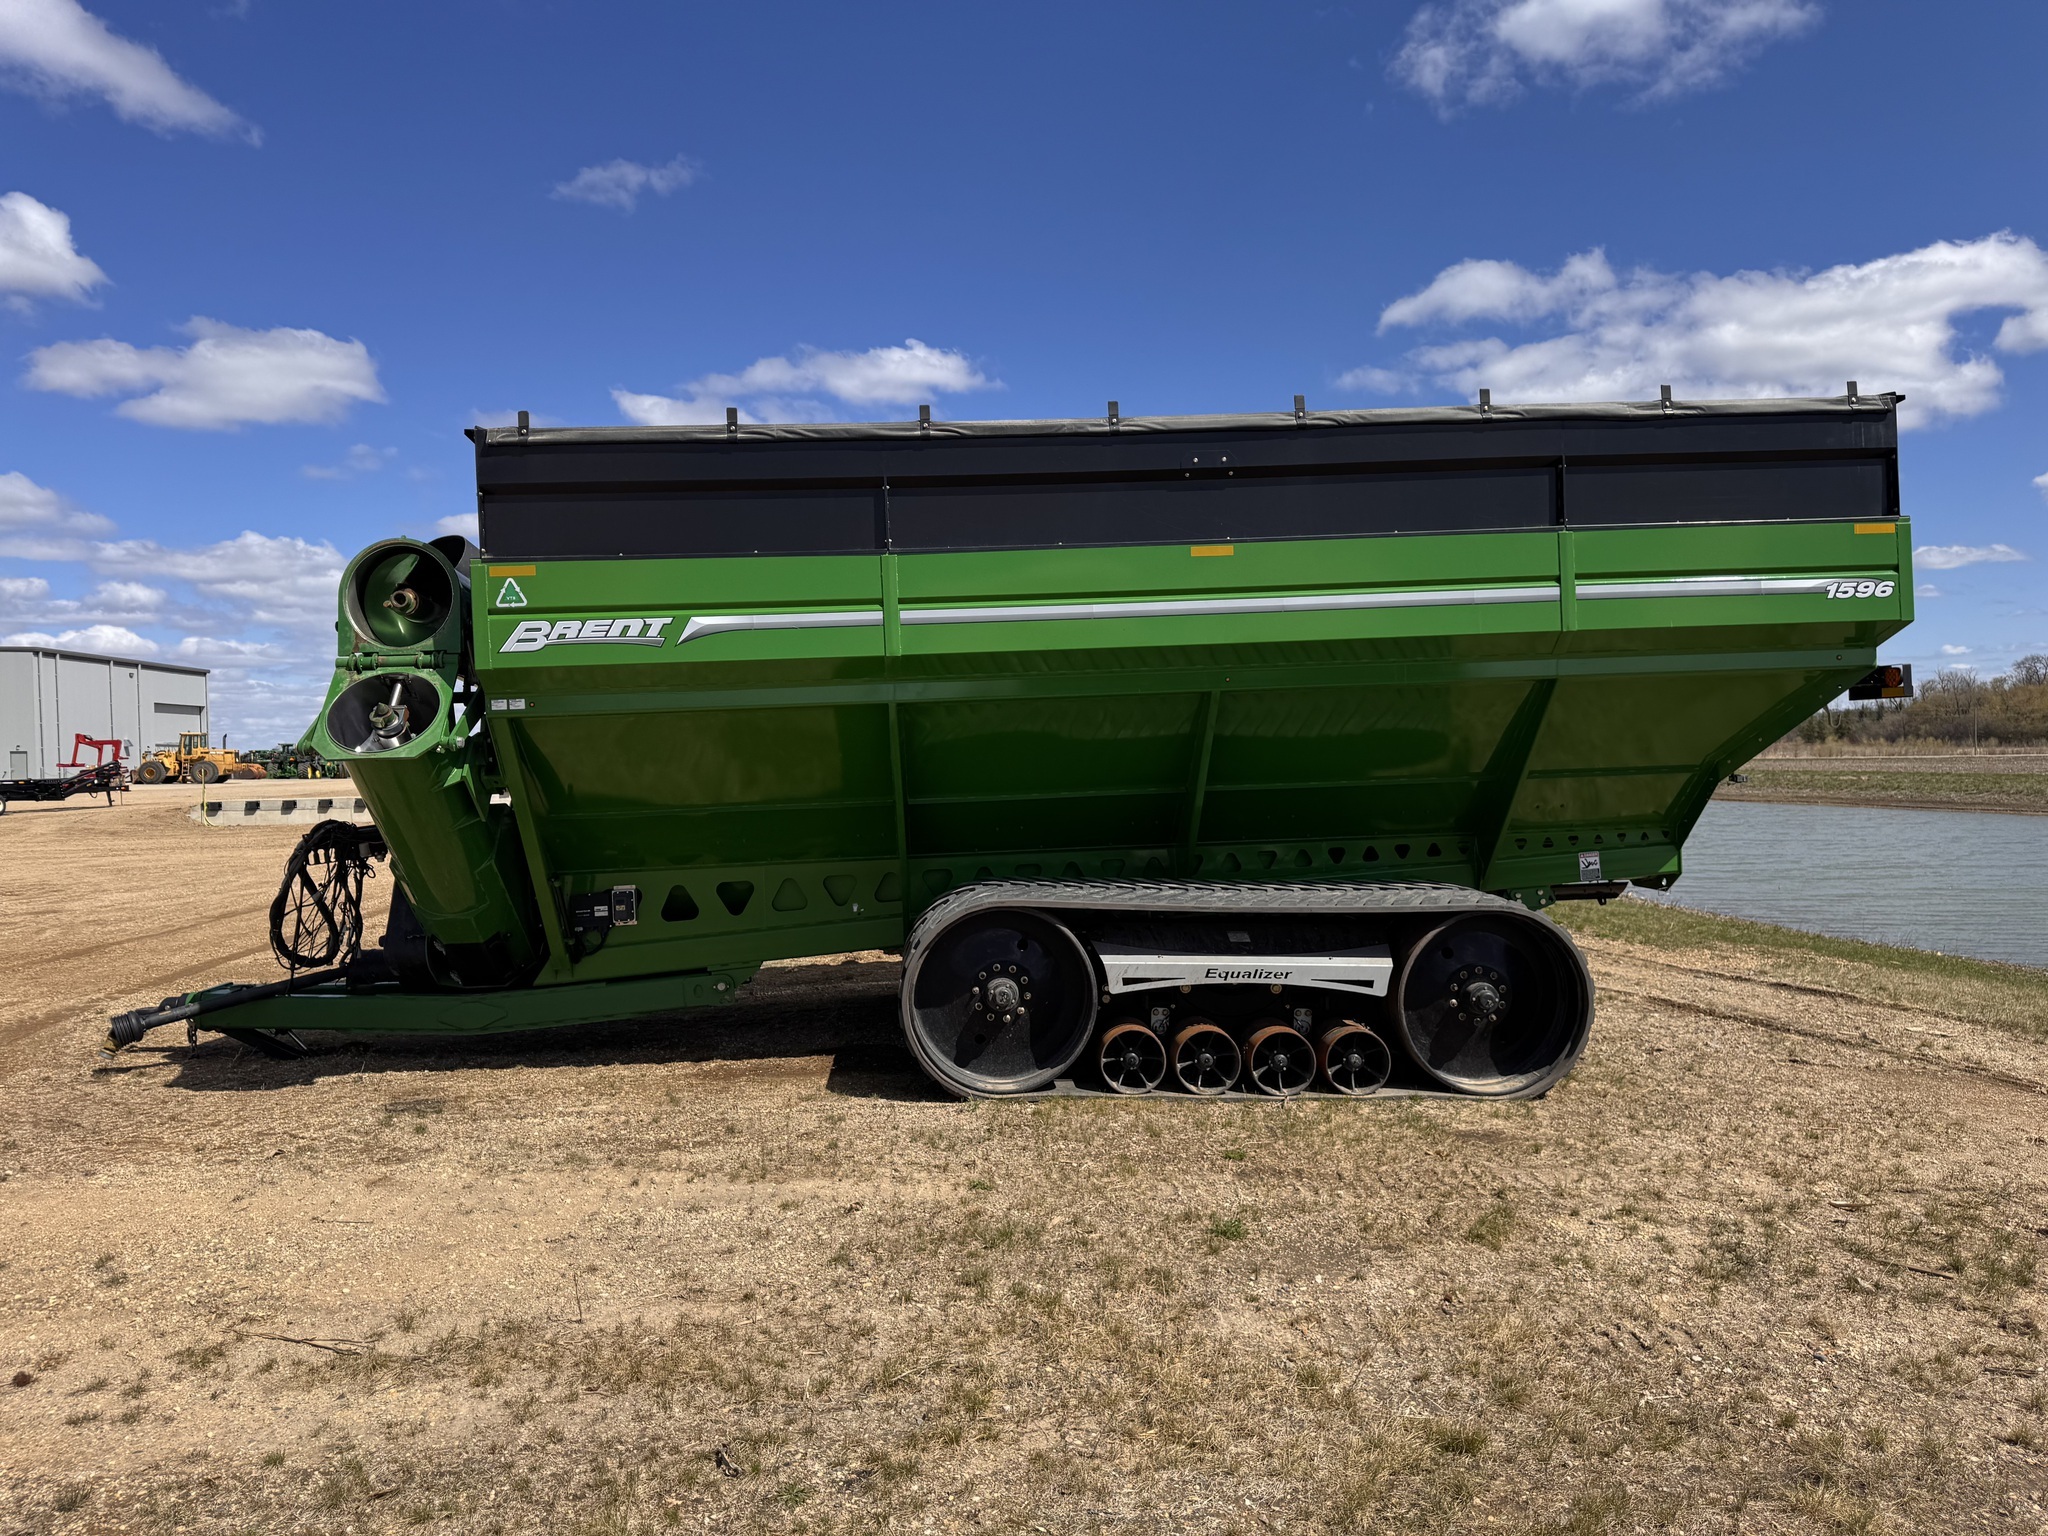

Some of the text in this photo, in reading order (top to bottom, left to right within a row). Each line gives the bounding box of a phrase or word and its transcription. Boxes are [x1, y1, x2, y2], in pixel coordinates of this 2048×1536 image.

[1826, 581, 1895, 599] 1596
[499, 617, 673, 653] BRENT
[1204, 968, 1293, 981] Equalizer
